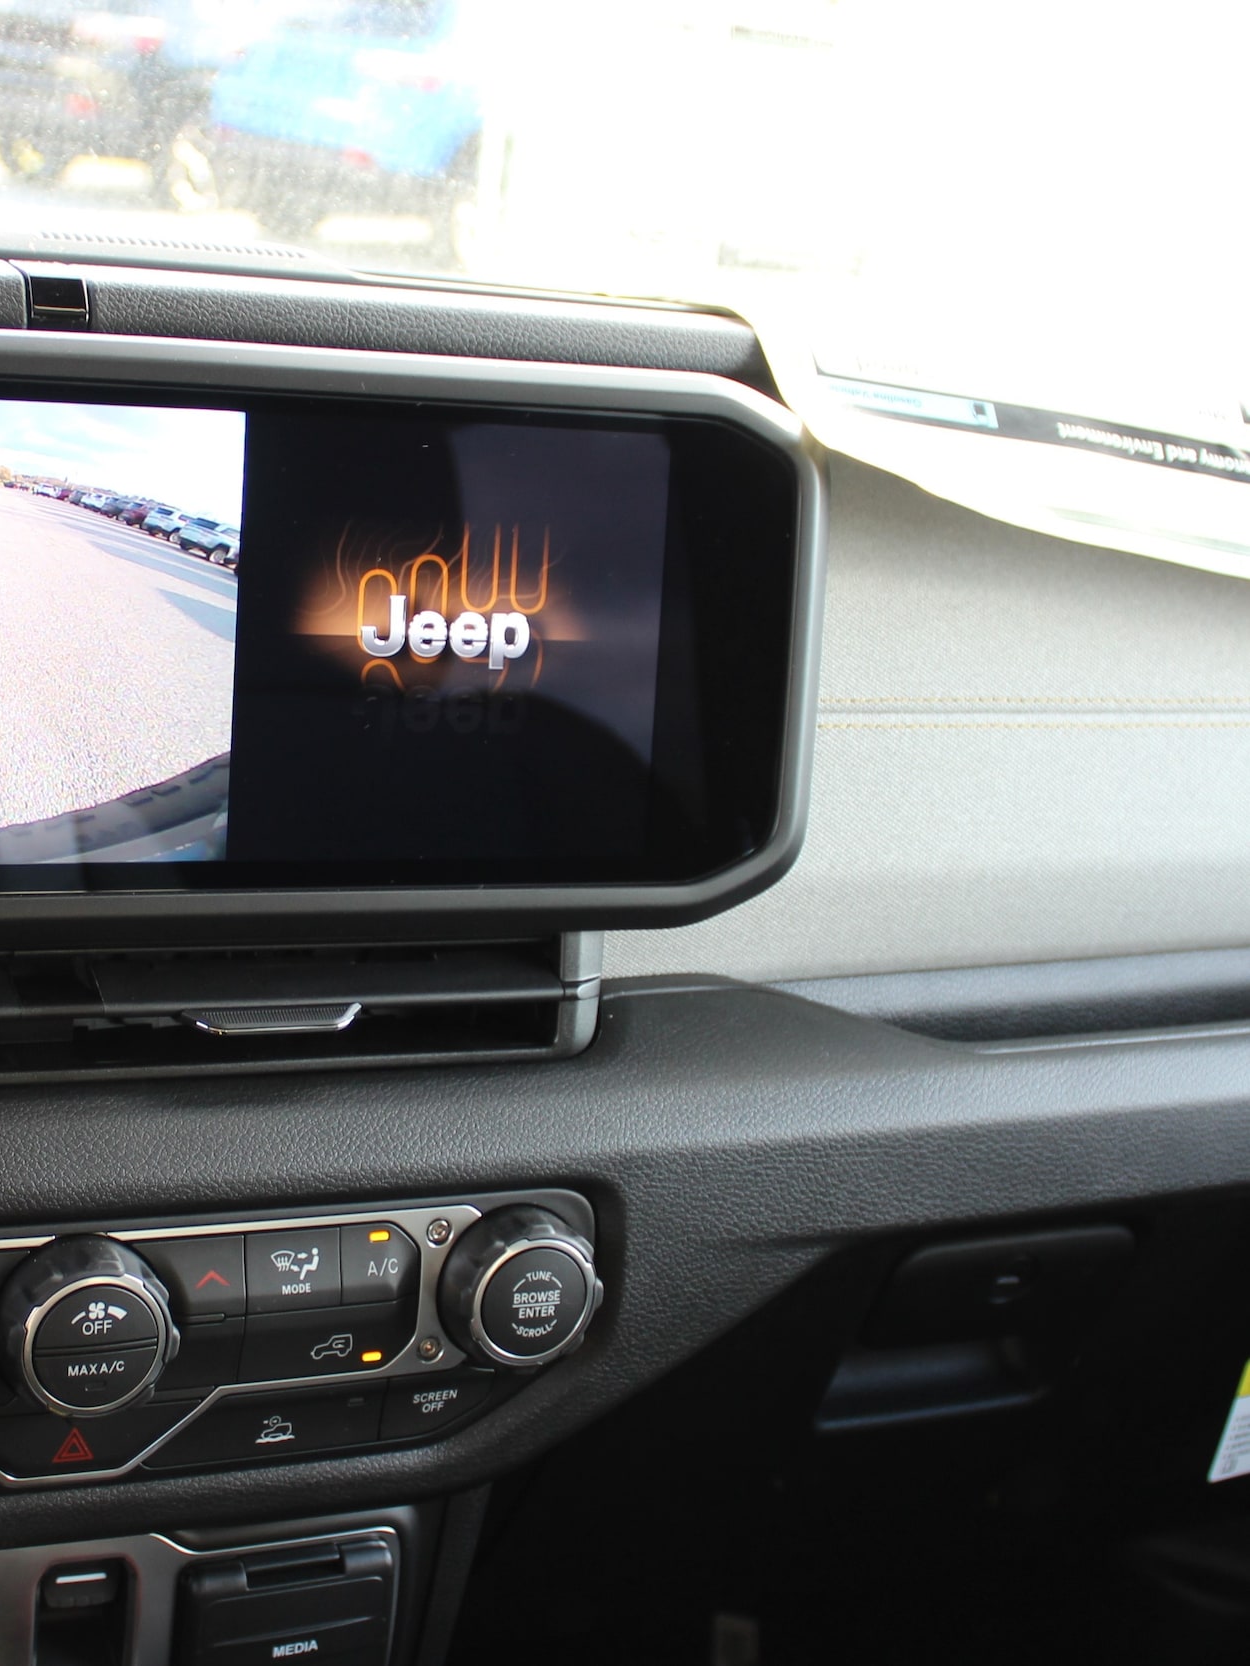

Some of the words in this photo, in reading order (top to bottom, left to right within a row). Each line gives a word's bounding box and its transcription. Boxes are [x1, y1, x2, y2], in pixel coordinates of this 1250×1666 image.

[1056, 422, 1165, 462] Environment
[1165, 443, 1198, 464] and
[361, 595, 530, 670] Jeep
[367, 1257, 399, 1277] A/C
[525, 1270, 552, 1283] TUNE
[281, 1282, 312, 1296] MODE
[513, 1290, 561, 1305] BROWSE
[518, 1305, 556, 1319] ENTER
[82, 1318, 113, 1336] OFF
[516, 1323, 553, 1339] SCROLL
[67, 1361, 99, 1377] MAX
[99, 1359, 125, 1375] A/C
[412, 1388, 458, 1405] SCREEN
[421, 1400, 445, 1414] OFF
[272, 1639, 318, 1658] MEDIA
